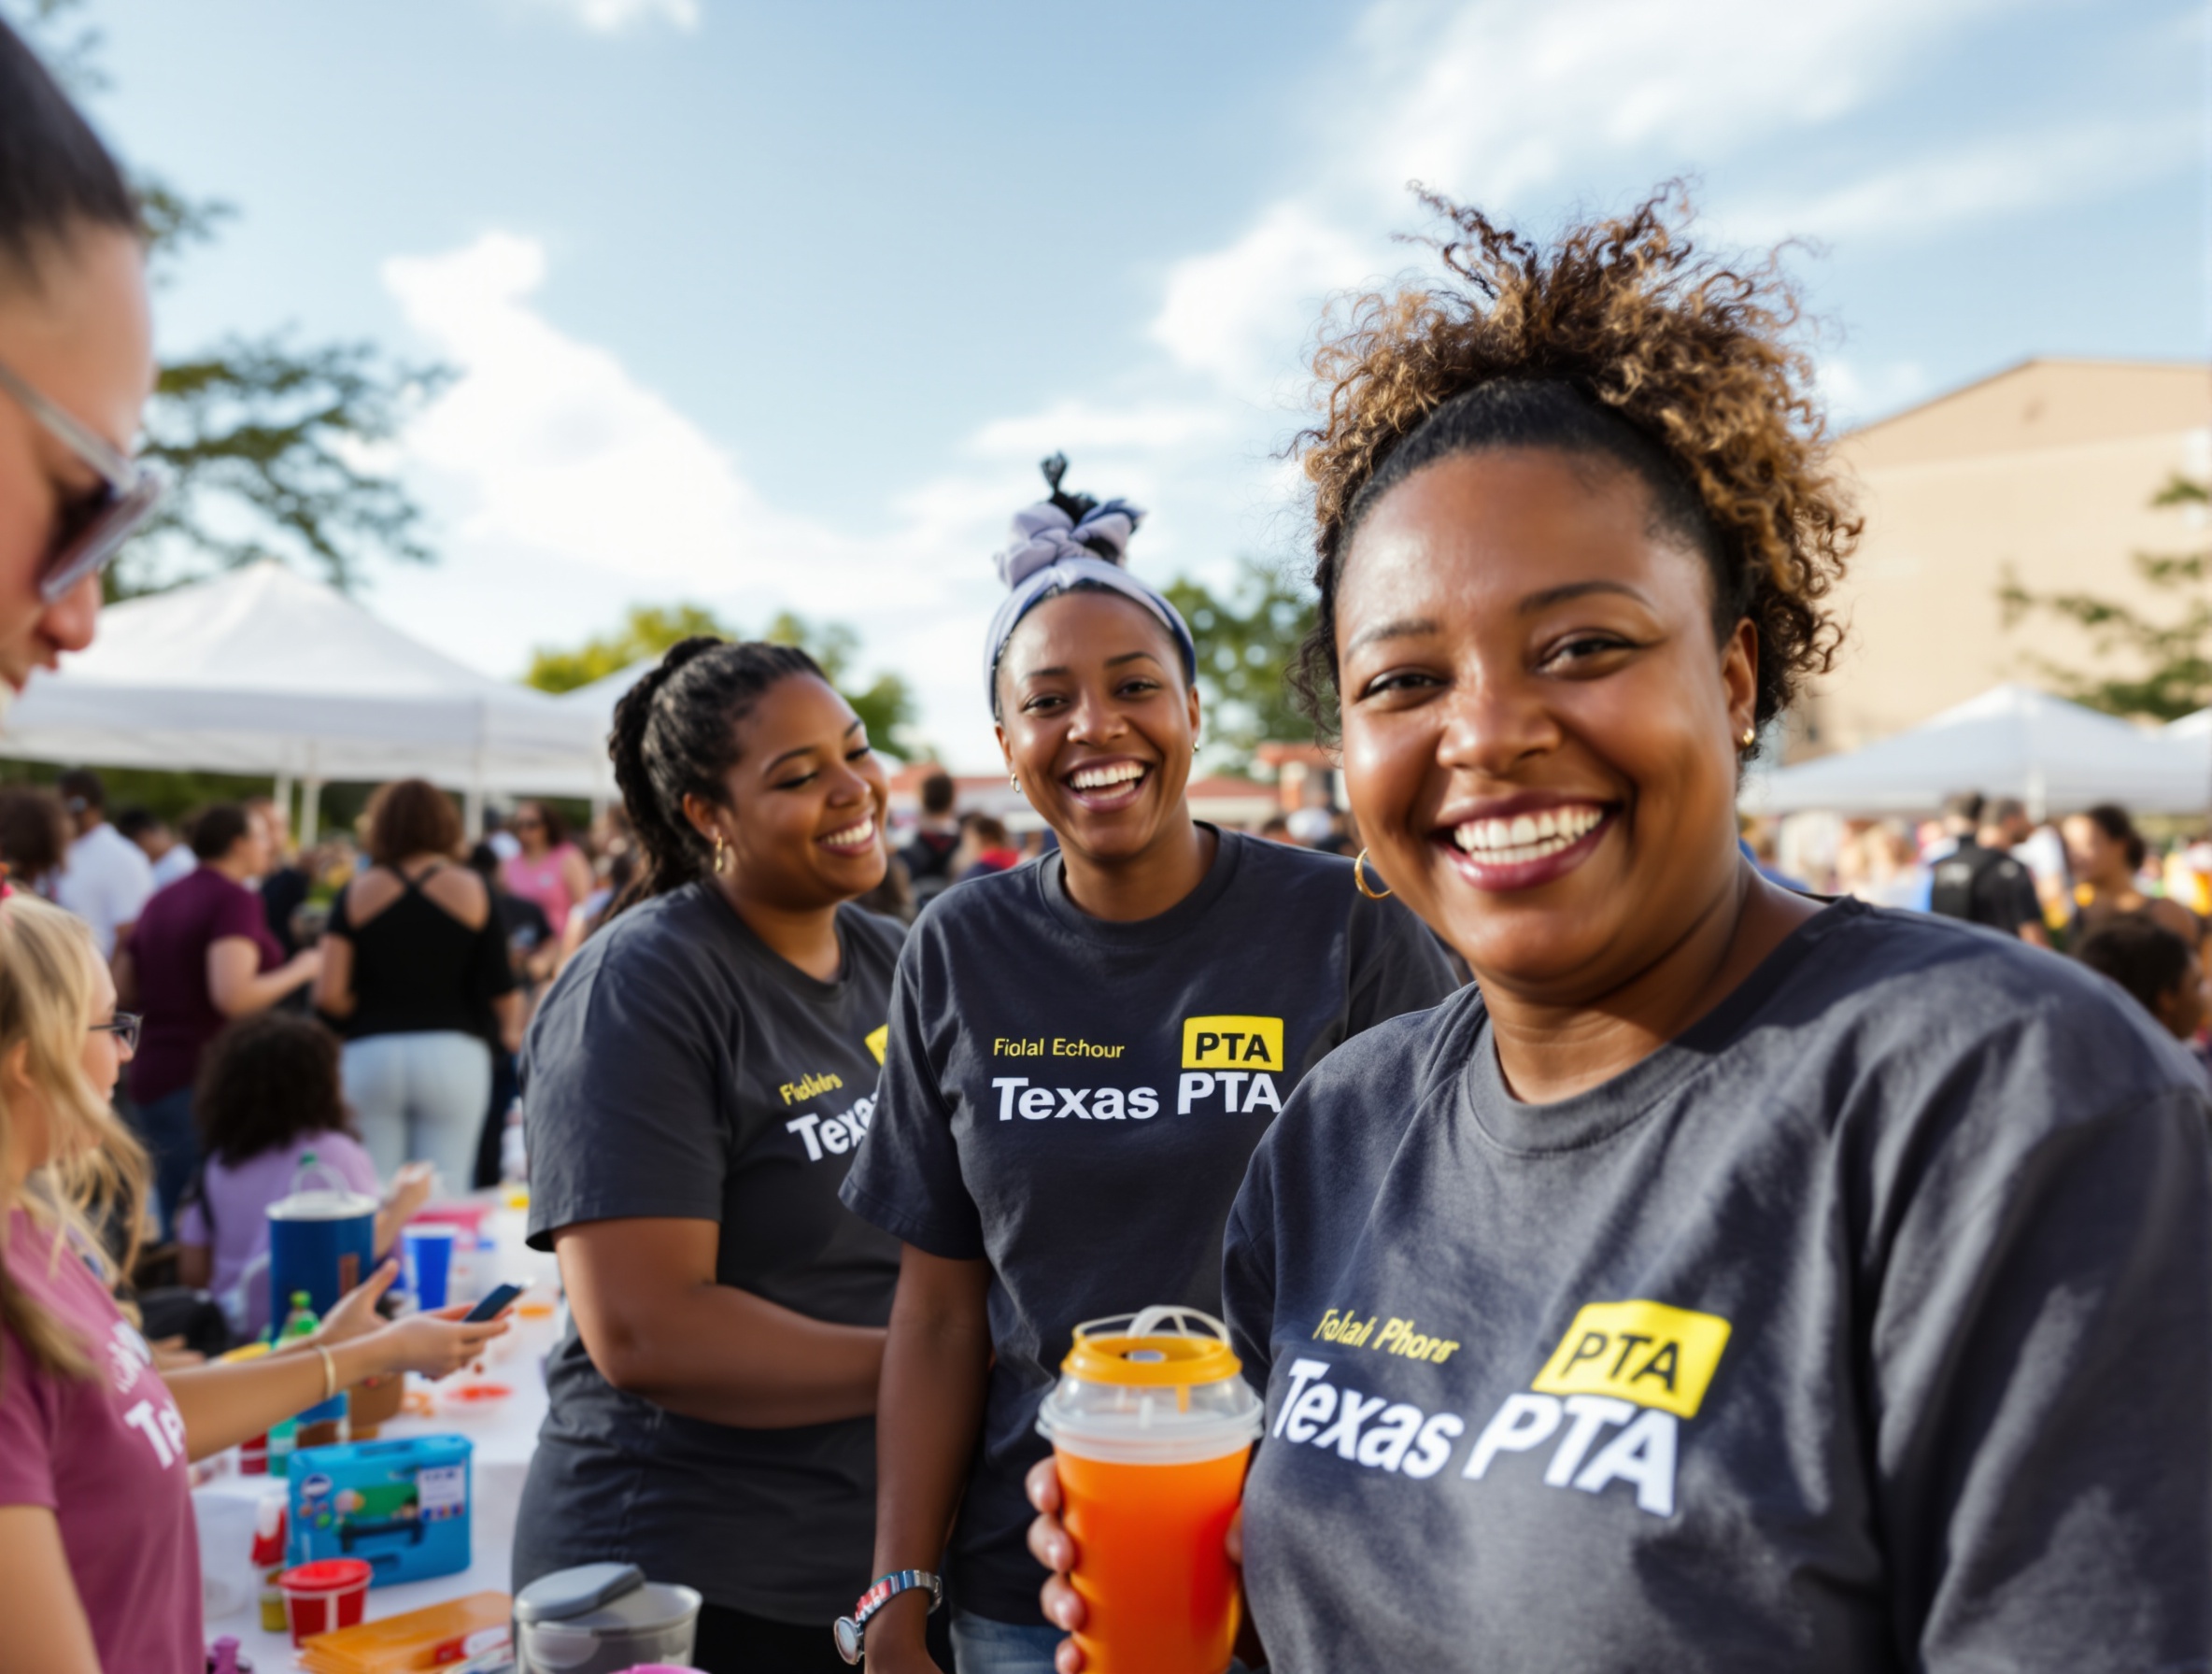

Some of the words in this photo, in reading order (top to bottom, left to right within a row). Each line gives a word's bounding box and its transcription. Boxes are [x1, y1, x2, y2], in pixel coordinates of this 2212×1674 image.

[1052, 1038, 1125, 1058] Echour
[1195, 1032, 1271, 1062] PTA
[991, 1077, 1159, 1121] Texas
[1177, 1071, 1282, 1114] PTA
[786, 1092, 878, 1162] Texa
[1559, 1332, 1680, 1393] PTA
[1273, 1358, 1464, 1479] Texas
[1461, 1393, 1678, 1518] PTA
